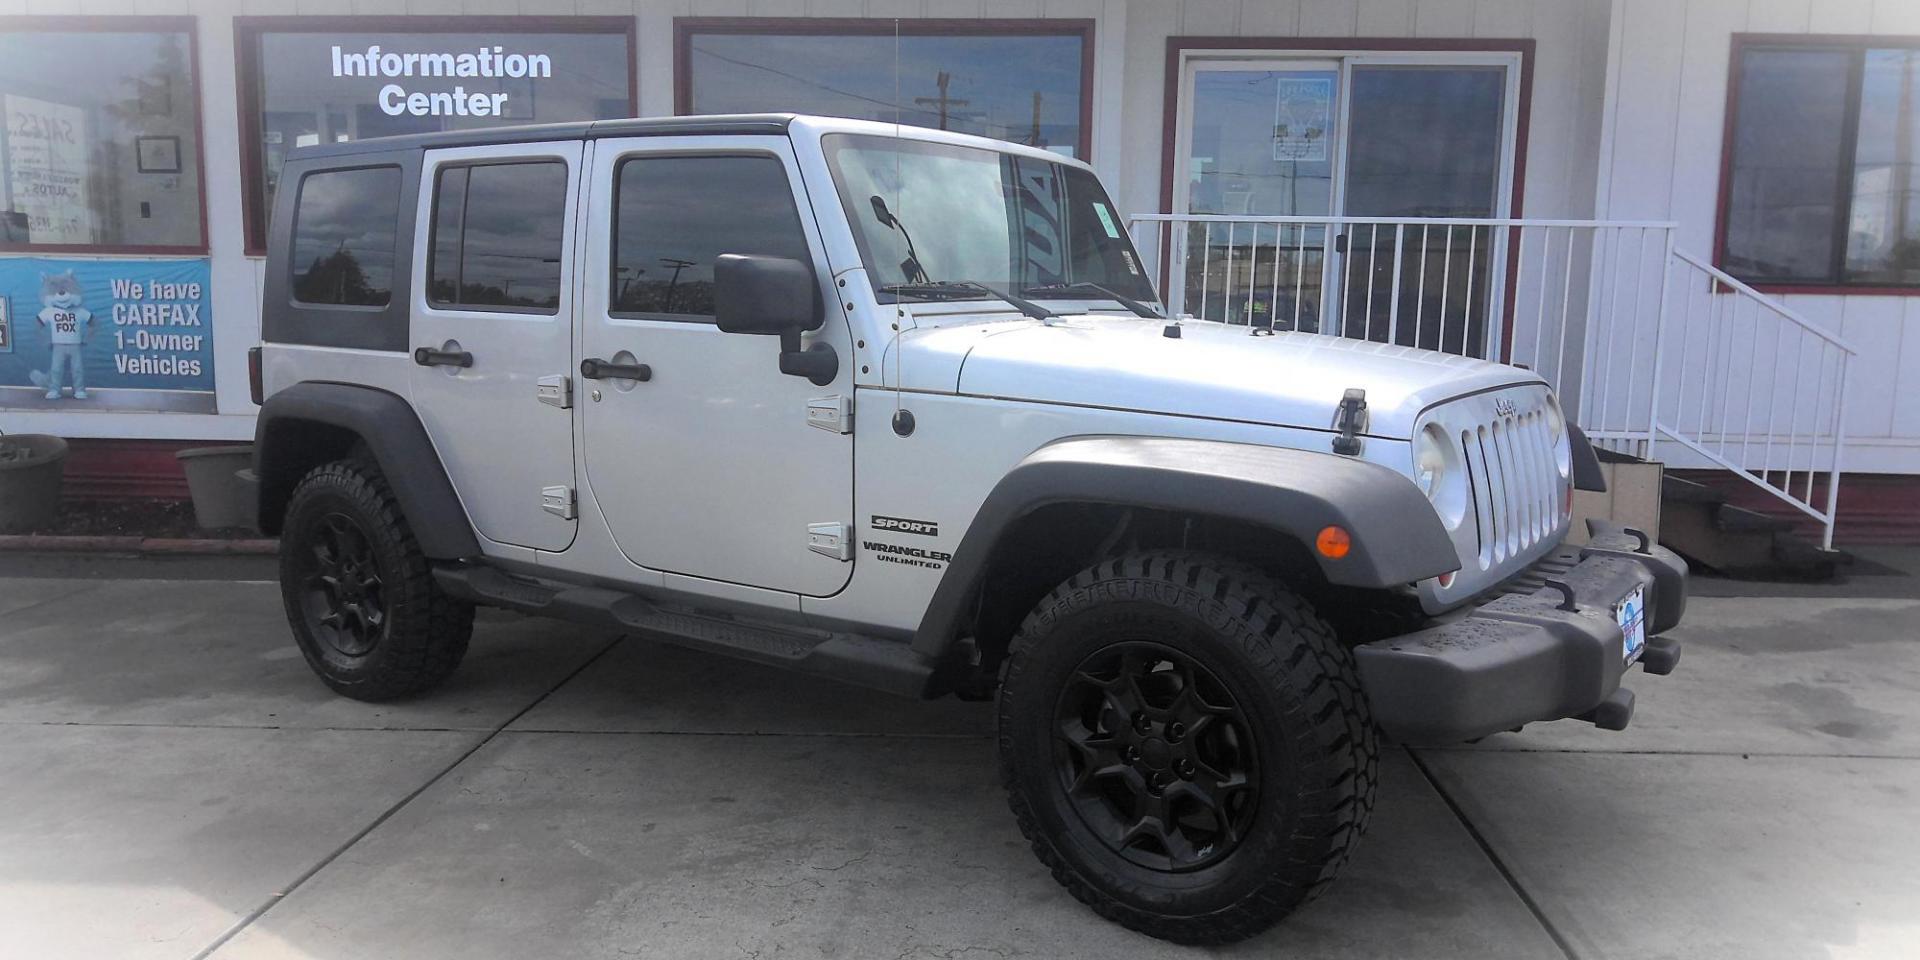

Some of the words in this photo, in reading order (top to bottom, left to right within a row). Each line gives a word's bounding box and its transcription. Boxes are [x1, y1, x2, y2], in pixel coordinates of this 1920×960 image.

[331, 45, 551, 78] Information
[378, 84, 508, 116] Center
[110, 278, 143, 300] We
[150, 279, 201, 300] have
[54, 312, 76, 323] CAR
[112, 303, 201, 327] CARFAX
[56, 323, 76, 333] FOX
[114, 330, 203, 351] 1-Owner
[114, 353, 201, 376] Vehicles
[872, 518, 938, 533] SPORT
[863, 541, 953, 562] WRANGLER
[877, 554, 942, 569] UNLIMITED
